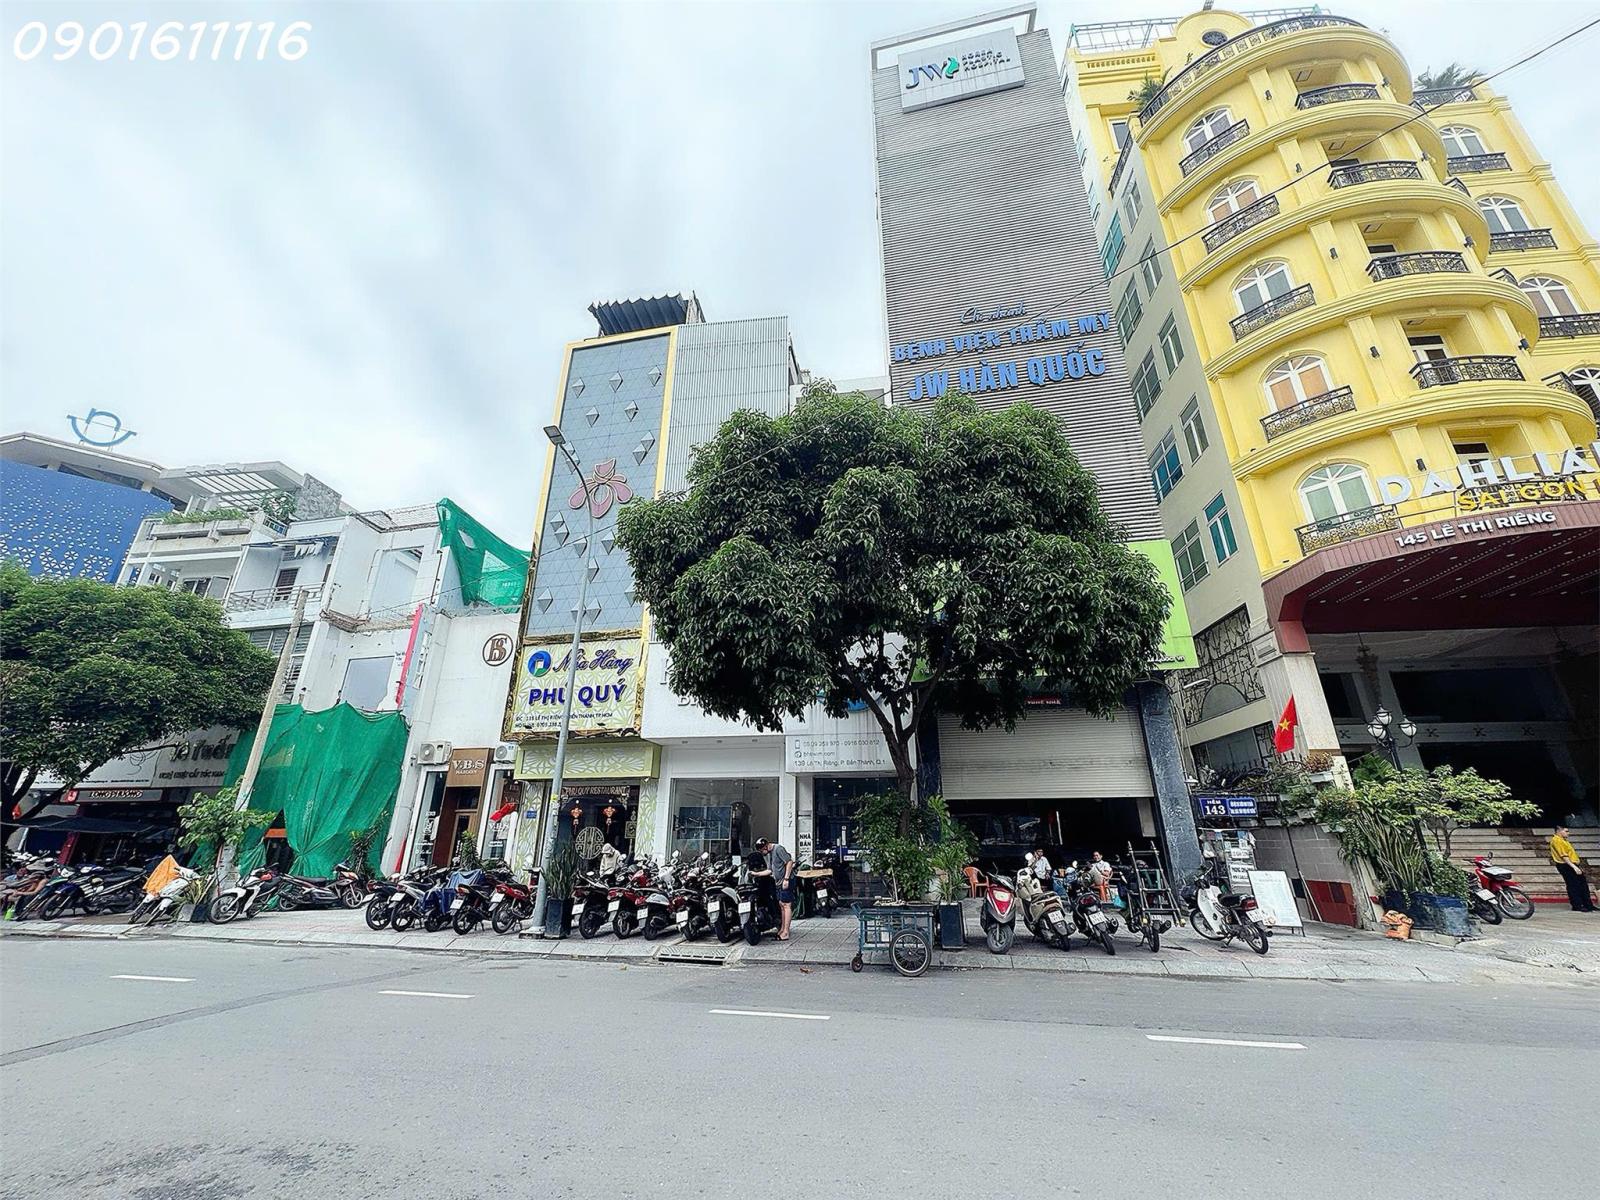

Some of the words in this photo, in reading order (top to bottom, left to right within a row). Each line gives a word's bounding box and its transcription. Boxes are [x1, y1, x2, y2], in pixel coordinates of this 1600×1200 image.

[894, 339, 948, 364] BỆNH
[953, 329, 1001, 353] VIỆN
[1009, 318, 1072, 346] THẨM
[1078, 310, 1111, 334] MỸ
[908, 370, 950, 401] JW
[958, 359, 1019, 394] HÀN
[1027, 341, 1106, 387] QUỐC
[1457, 479, 1587, 511] SAIGON
[1395, 532, 1428, 548] 145
[1430, 525, 1457, 541] LÊ
[1458, 519, 1494, 534] THỊ
[1498, 511, 1557, 529] RIÊNG
[589, 649, 634, 675] Hàng
[577, 678, 627, 708] QUÝ
[1204, 805, 1227, 815] 143
